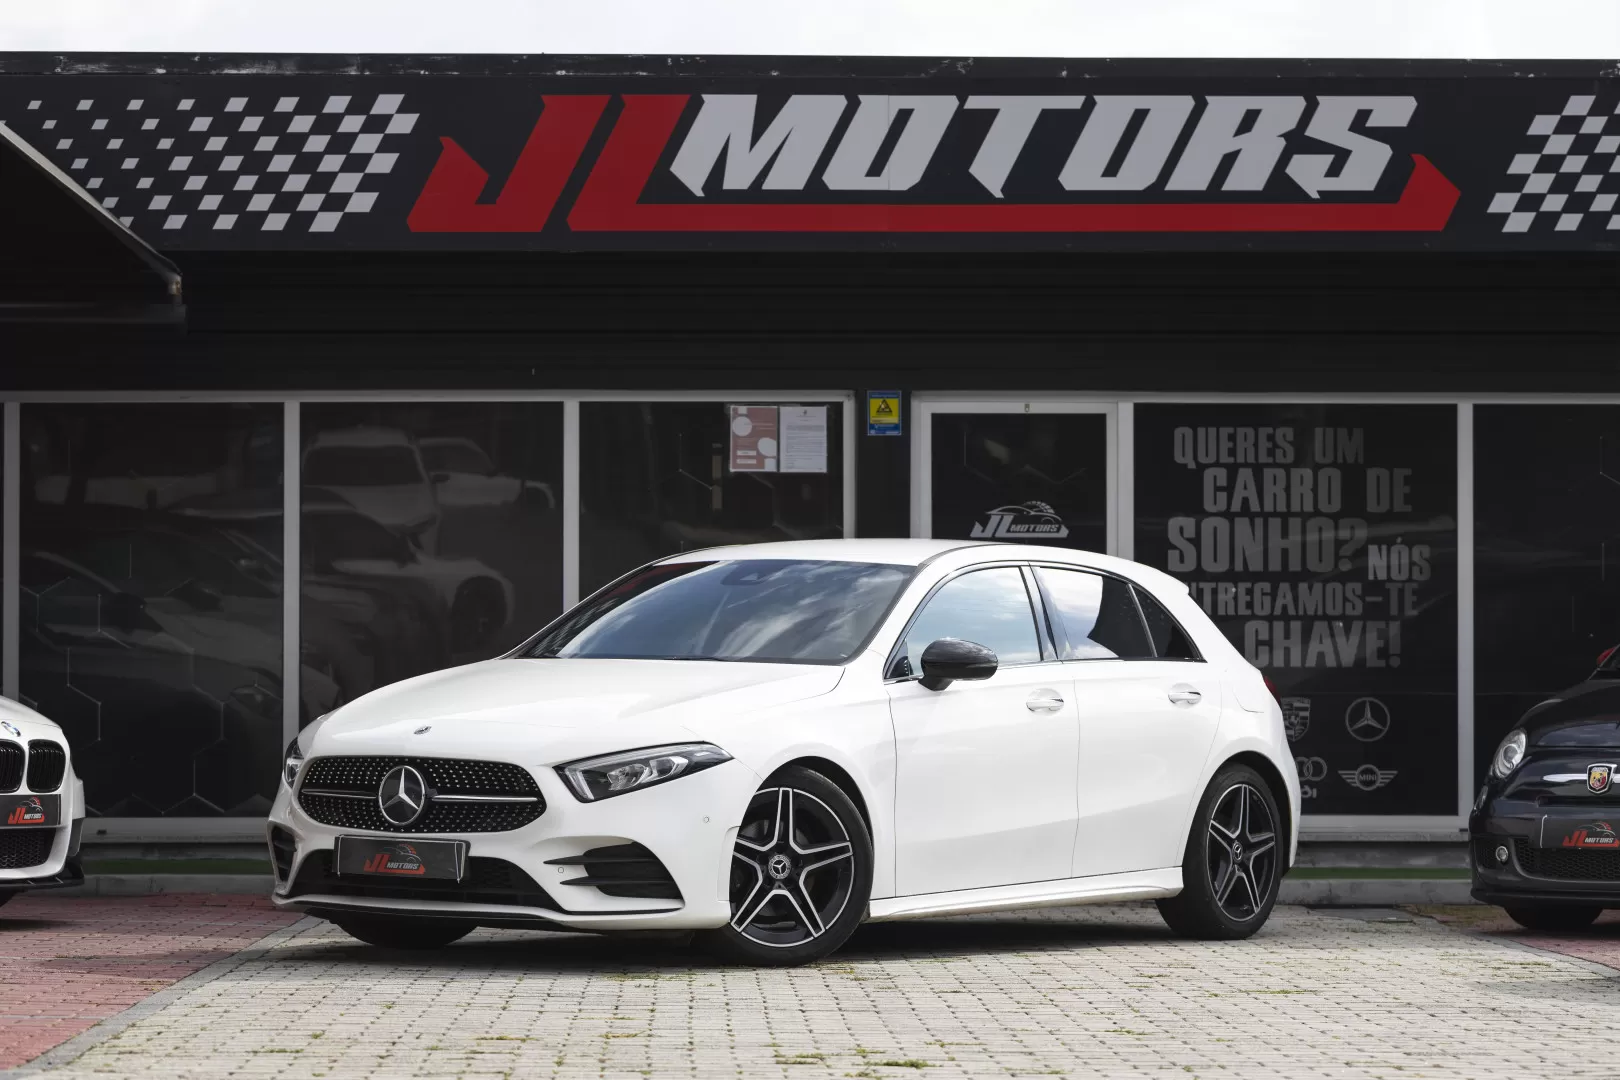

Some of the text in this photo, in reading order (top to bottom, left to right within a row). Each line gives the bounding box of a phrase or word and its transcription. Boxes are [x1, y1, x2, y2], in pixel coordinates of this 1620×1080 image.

[407, 93, 1418, 232] JL MOTORS
[1173, 427, 1364, 469] QUERES UM
[1203, 467, 1412, 513] CARRO DE
[970, 514, 1060, 538] JL MOTORS
[1167, 516, 1431, 581] SONHO? NÓS
[1187, 582, 1419, 616] TREGAMOS-TE
[1244, 620, 1401, 668] CHAVE!
[386, 862, 419, 870] MOTORS
